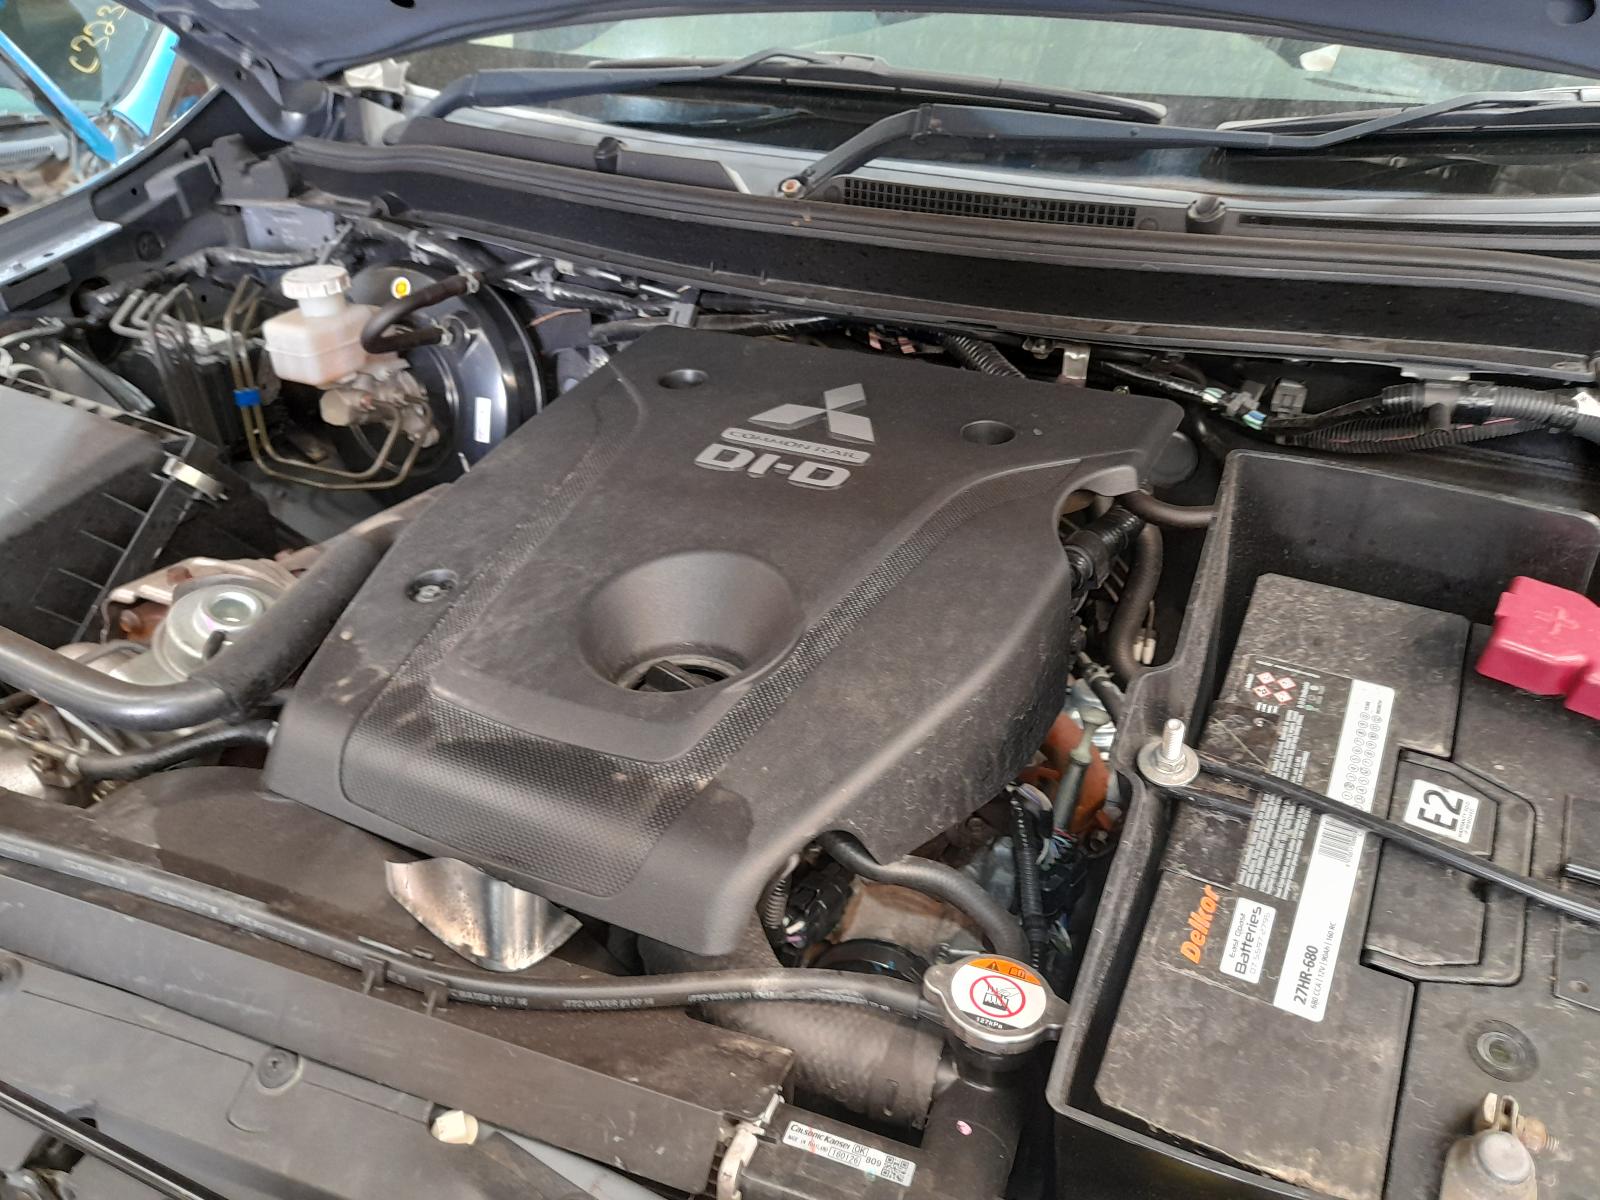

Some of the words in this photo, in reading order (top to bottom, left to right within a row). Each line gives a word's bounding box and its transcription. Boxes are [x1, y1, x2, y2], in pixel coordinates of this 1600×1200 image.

[729, 430, 812, 451] COMMON
[814, 446, 862, 460] RAIL
[695, 443, 851, 489] DI-D
[1417, 790, 1463, 831] E2
[1180, 884, 1219, 964] Delkor
[1328, 921, 1337, 931] RC
[1228, 939, 1240, 959] East
[1235, 913, 1246, 937] Coast
[1235, 906, 1262, 975] Batteries
[1325, 930, 1335, 942] 160
[1321, 945, 1330, 962] 90Ah
[1293, 945, 1318, 1006] 27HR-680
[1317, 965, 1326, 978] 12V
[1313, 982, 1322, 997] CCA
[1310, 996, 1319, 1010] 680
[975, 1016, 1003, 1030] 127kPa
[831, 1149, 859, 1164] 160126
[854, 1144, 867, 1155] OK
[865, 1156, 882, 1167] 809
